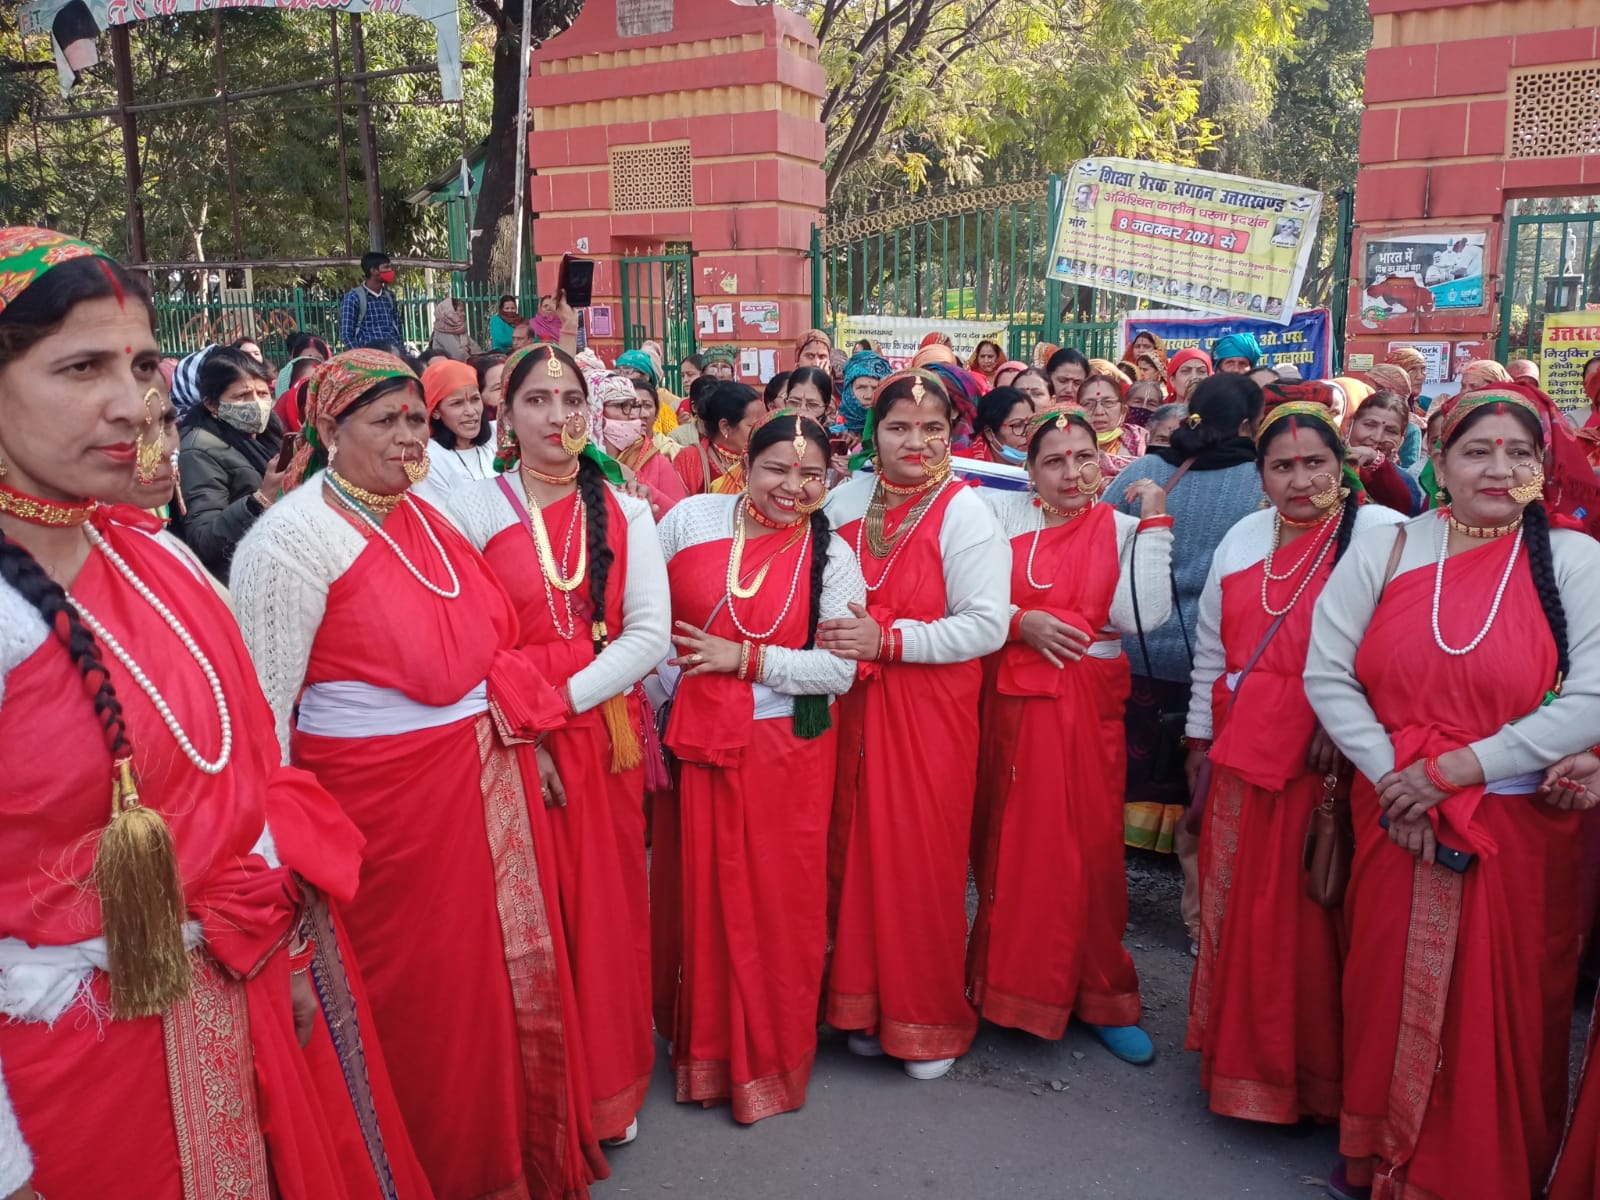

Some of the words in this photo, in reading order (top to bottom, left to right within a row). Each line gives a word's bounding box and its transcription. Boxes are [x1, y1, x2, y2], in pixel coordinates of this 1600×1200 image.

[1099, 166, 1136, 187] शिक्षा
[1138, 171, 1170, 193] प्रेरक
[1220, 189, 1287, 213] उत्तराखण्ड
[1157, 200, 1196, 216] कालीन
[1231, 213, 1270, 229] प्रदर्शन
[1119, 217, 1128, 230] 8
[1131, 219, 1184, 239] नवम्बर
[1185, 229, 1215, 245] 2021
[1220, 232, 1237, 249] से
[1379, 251, 1403, 264] भारत
[1404, 247, 1414, 263] में
[1544, 347, 1589, 361] नियुक्ति
